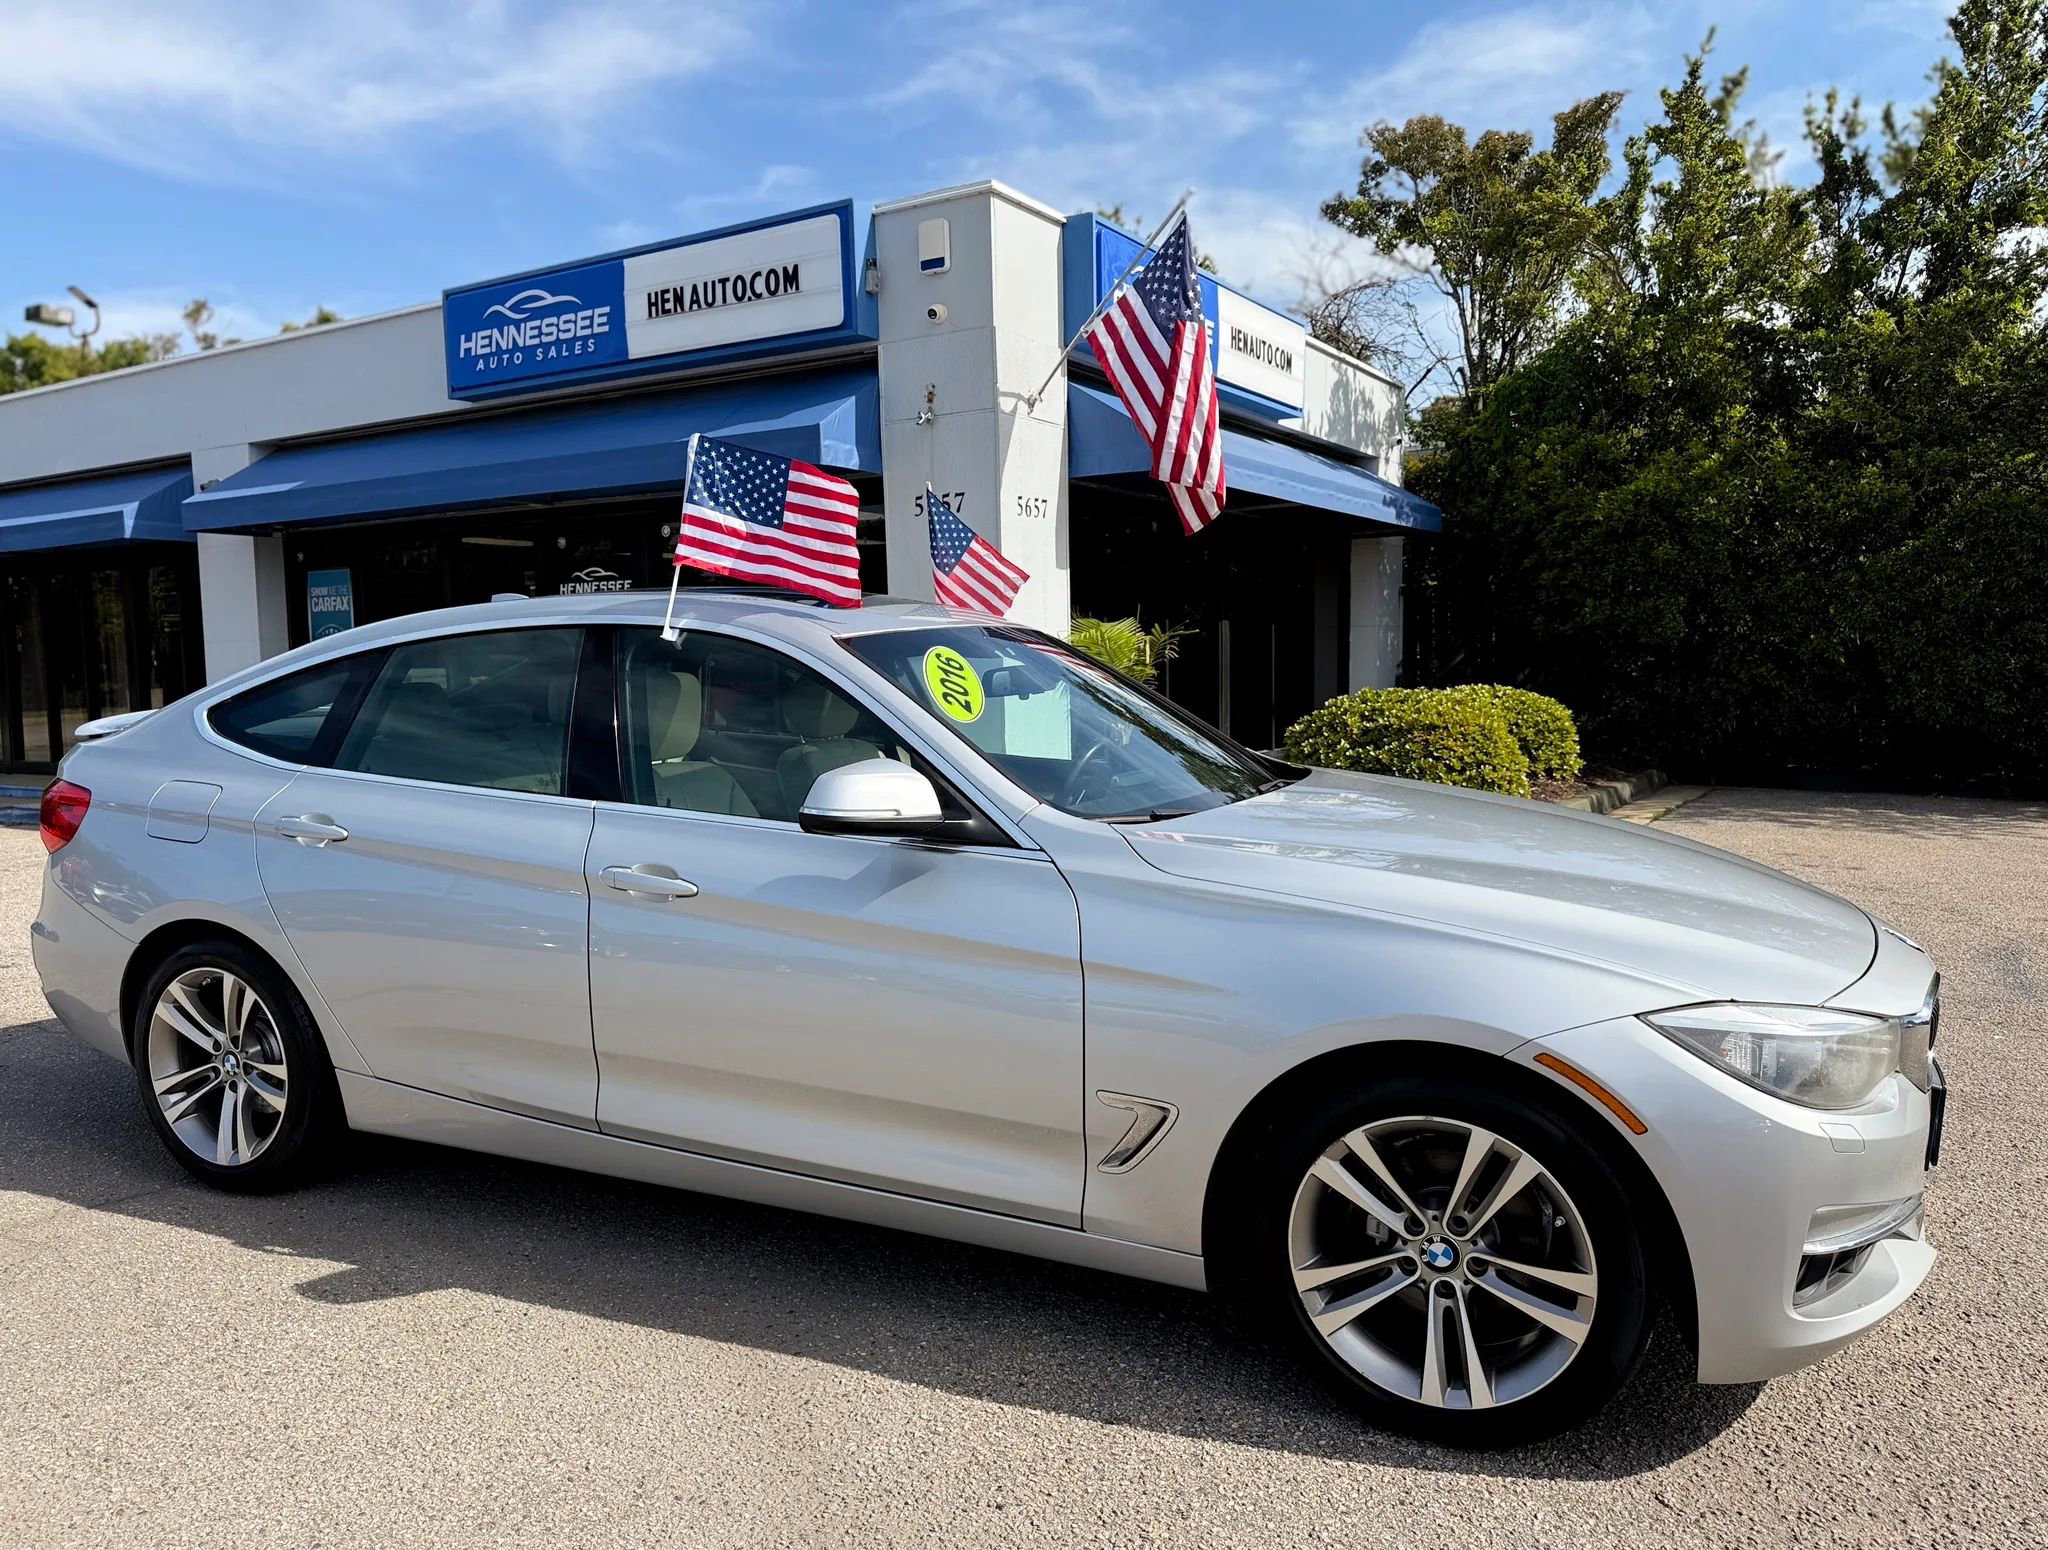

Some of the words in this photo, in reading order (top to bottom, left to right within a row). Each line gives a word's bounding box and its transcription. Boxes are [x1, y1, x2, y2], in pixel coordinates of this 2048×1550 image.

[647, 263, 800, 318] HENAUTO.COM
[460, 306, 611, 358] HENNESSEE
[476, 352, 523, 371] AUTO
[536, 339, 595, 361] SALES
[914, 491, 966, 517] 557
[1017, 496, 1048, 519] 5657
[310, 586, 328, 597] SHOW
[560, 580, 632, 595] HENNESSEE
[311, 596, 350, 613] CARFAX
[935, 652, 973, 715] 2016
